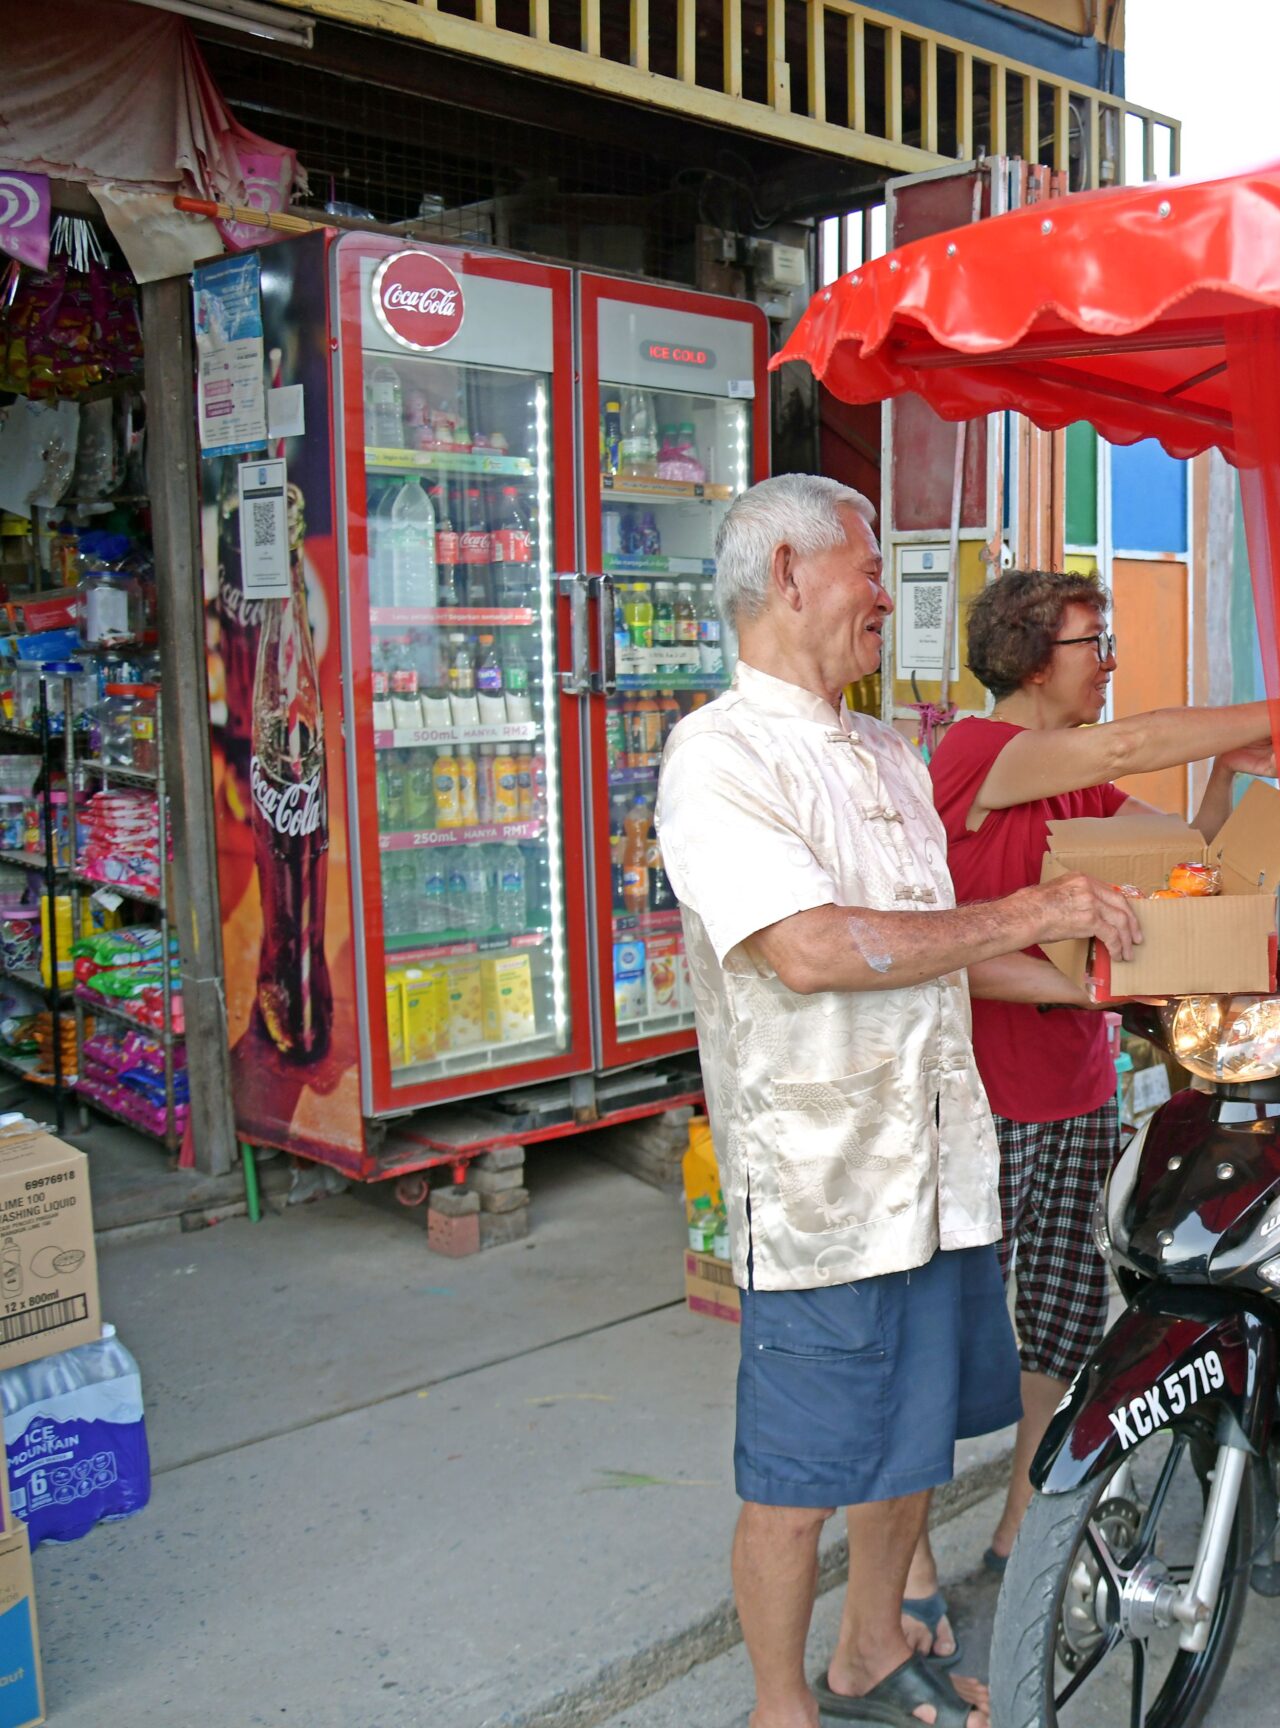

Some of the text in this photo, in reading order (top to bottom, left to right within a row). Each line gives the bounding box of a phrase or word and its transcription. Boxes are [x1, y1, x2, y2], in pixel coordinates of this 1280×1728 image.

[384, 283, 459, 316] Coca-Cola
[649, 344, 707, 364] ICE COLD
[414, 724, 528, 743] 500mL HANYA RM2
[249, 756, 322, 837] Coca-Cola
[413, 831, 457, 845] 250mL
[463, 829, 497, 840] HANYA
[24, 1170, 75, 1191] 69976918
[0, 1196, 77, 1224] ASHING LIQUID
[27, 1192, 46, 1205] 100
[5, 1301, 17, 1314] 12
[28, 1288, 59, 1307] 800ml
[1108, 1385, 1170, 1451] XCK
[1163, 1350, 1225, 1415] 5719
[25, 1424, 56, 1447] ICE
[7, 1434, 80, 1468] MOUNTAIN
[31, 1468, 48, 1496] 6
